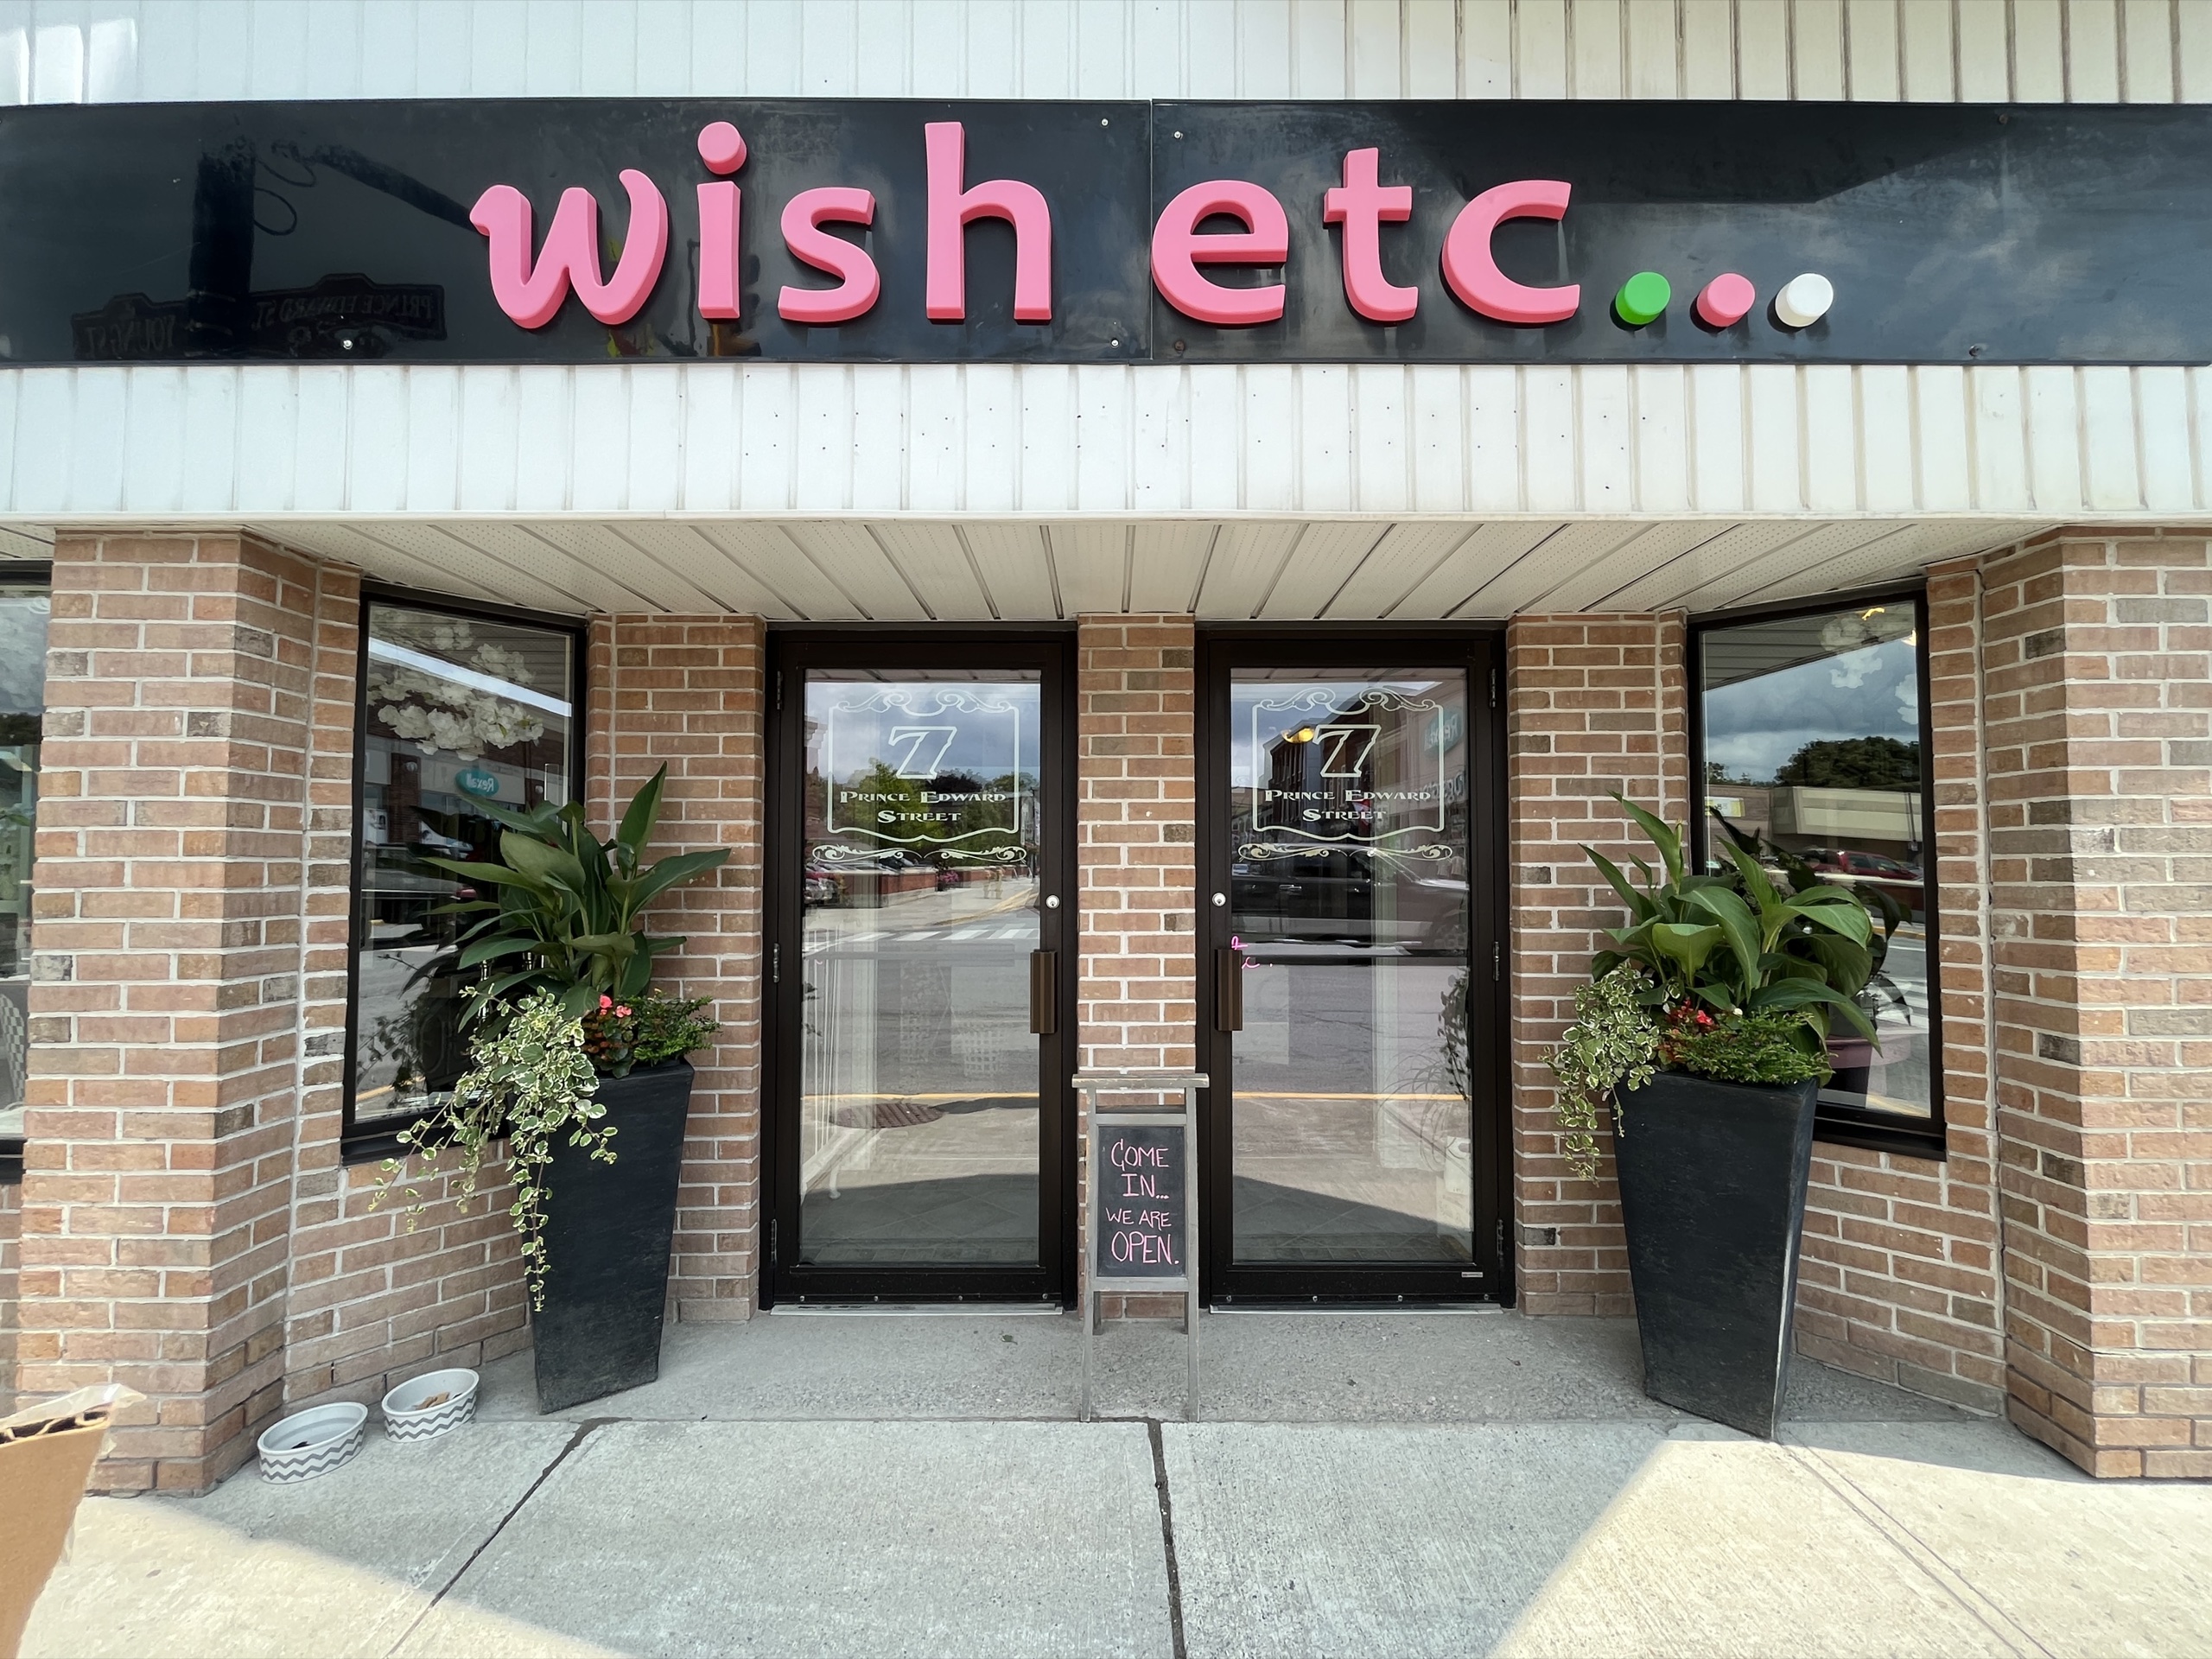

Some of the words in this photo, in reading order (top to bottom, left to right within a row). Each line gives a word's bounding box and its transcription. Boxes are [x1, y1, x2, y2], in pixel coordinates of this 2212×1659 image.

[470, 122, 1052, 330] wish
[888, 725, 958, 779] 77
[1312, 724, 1382, 779] 77
[1110, 1138, 1170, 1172] COME
[1104, 1206, 1135, 1225] WE
[1138, 1209, 1173, 1231] ARE
[1110, 1230, 1180, 1266] OPEN.
